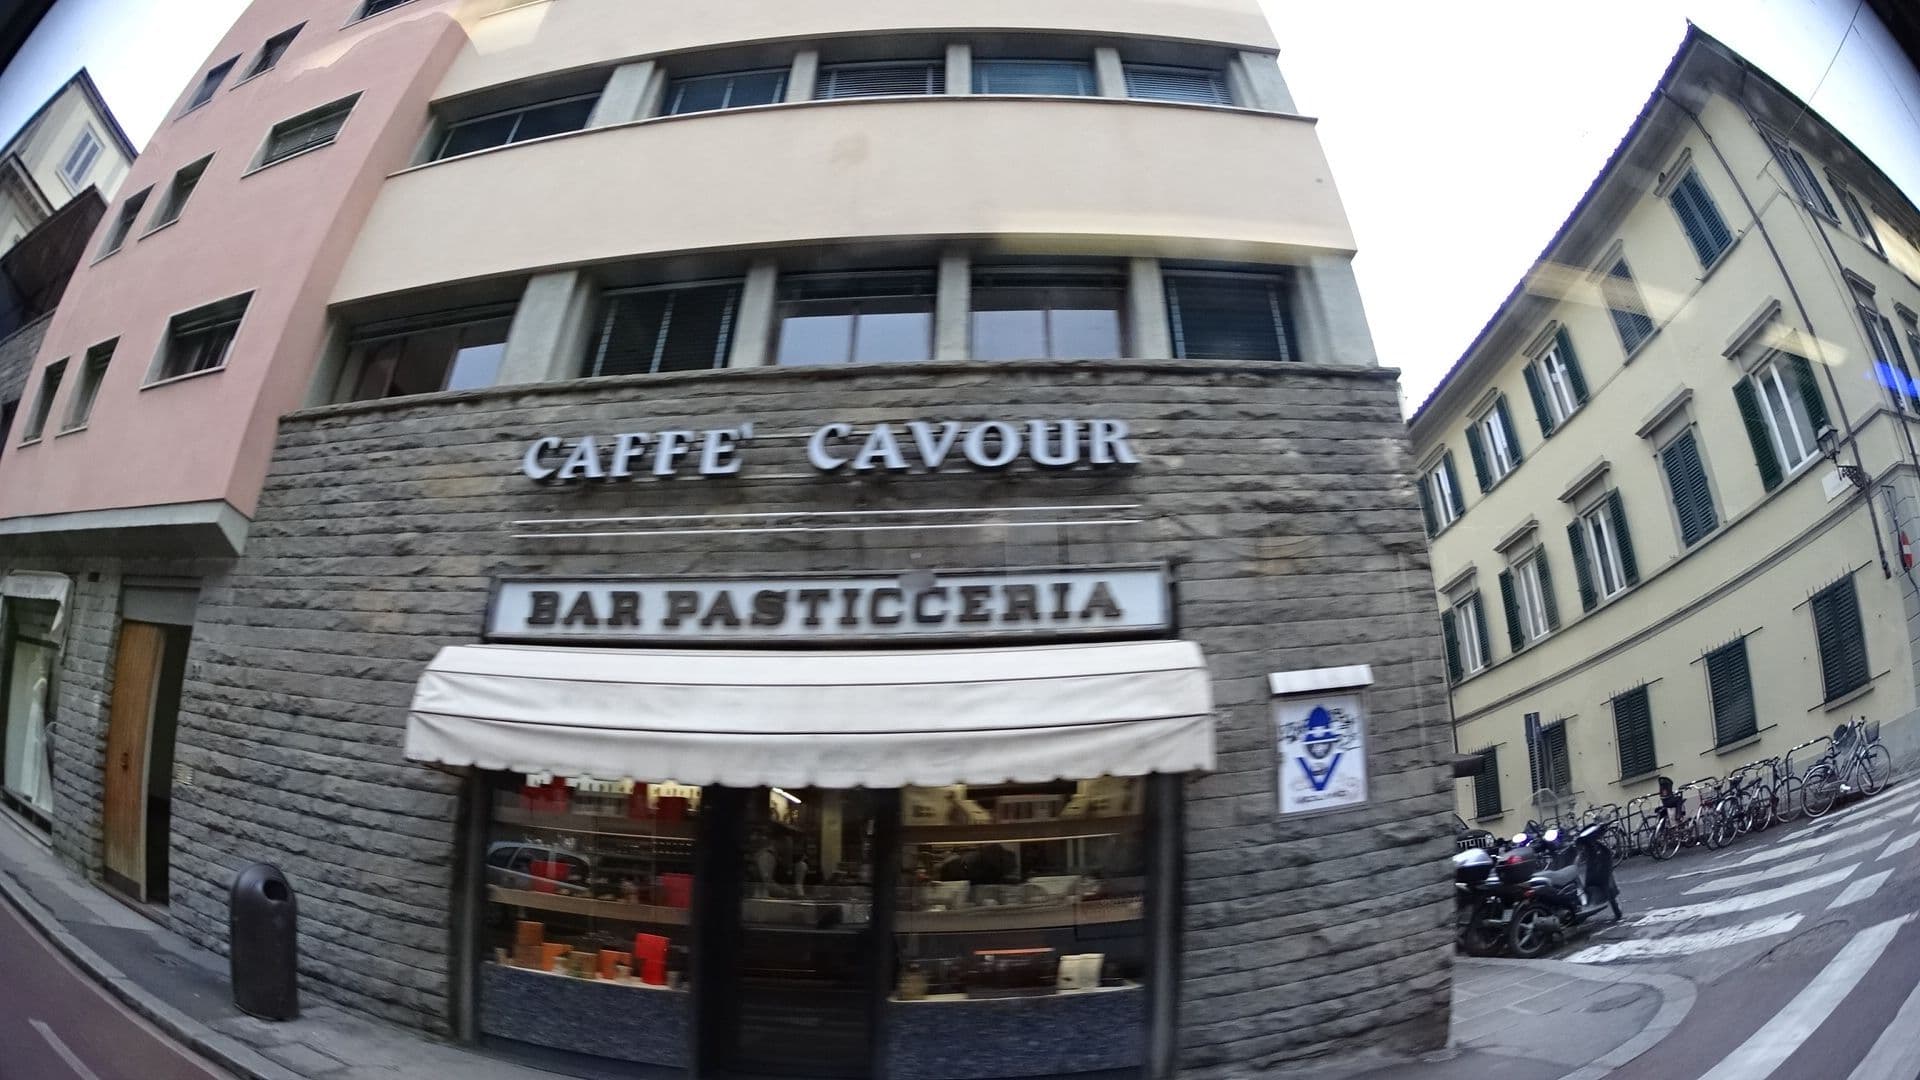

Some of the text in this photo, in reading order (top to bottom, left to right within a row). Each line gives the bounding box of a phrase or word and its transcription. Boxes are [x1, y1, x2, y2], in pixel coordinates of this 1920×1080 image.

[806, 419, 1142, 471] CAVOUR
[527, 581, 1122, 627] BAR PASTICCERIA
